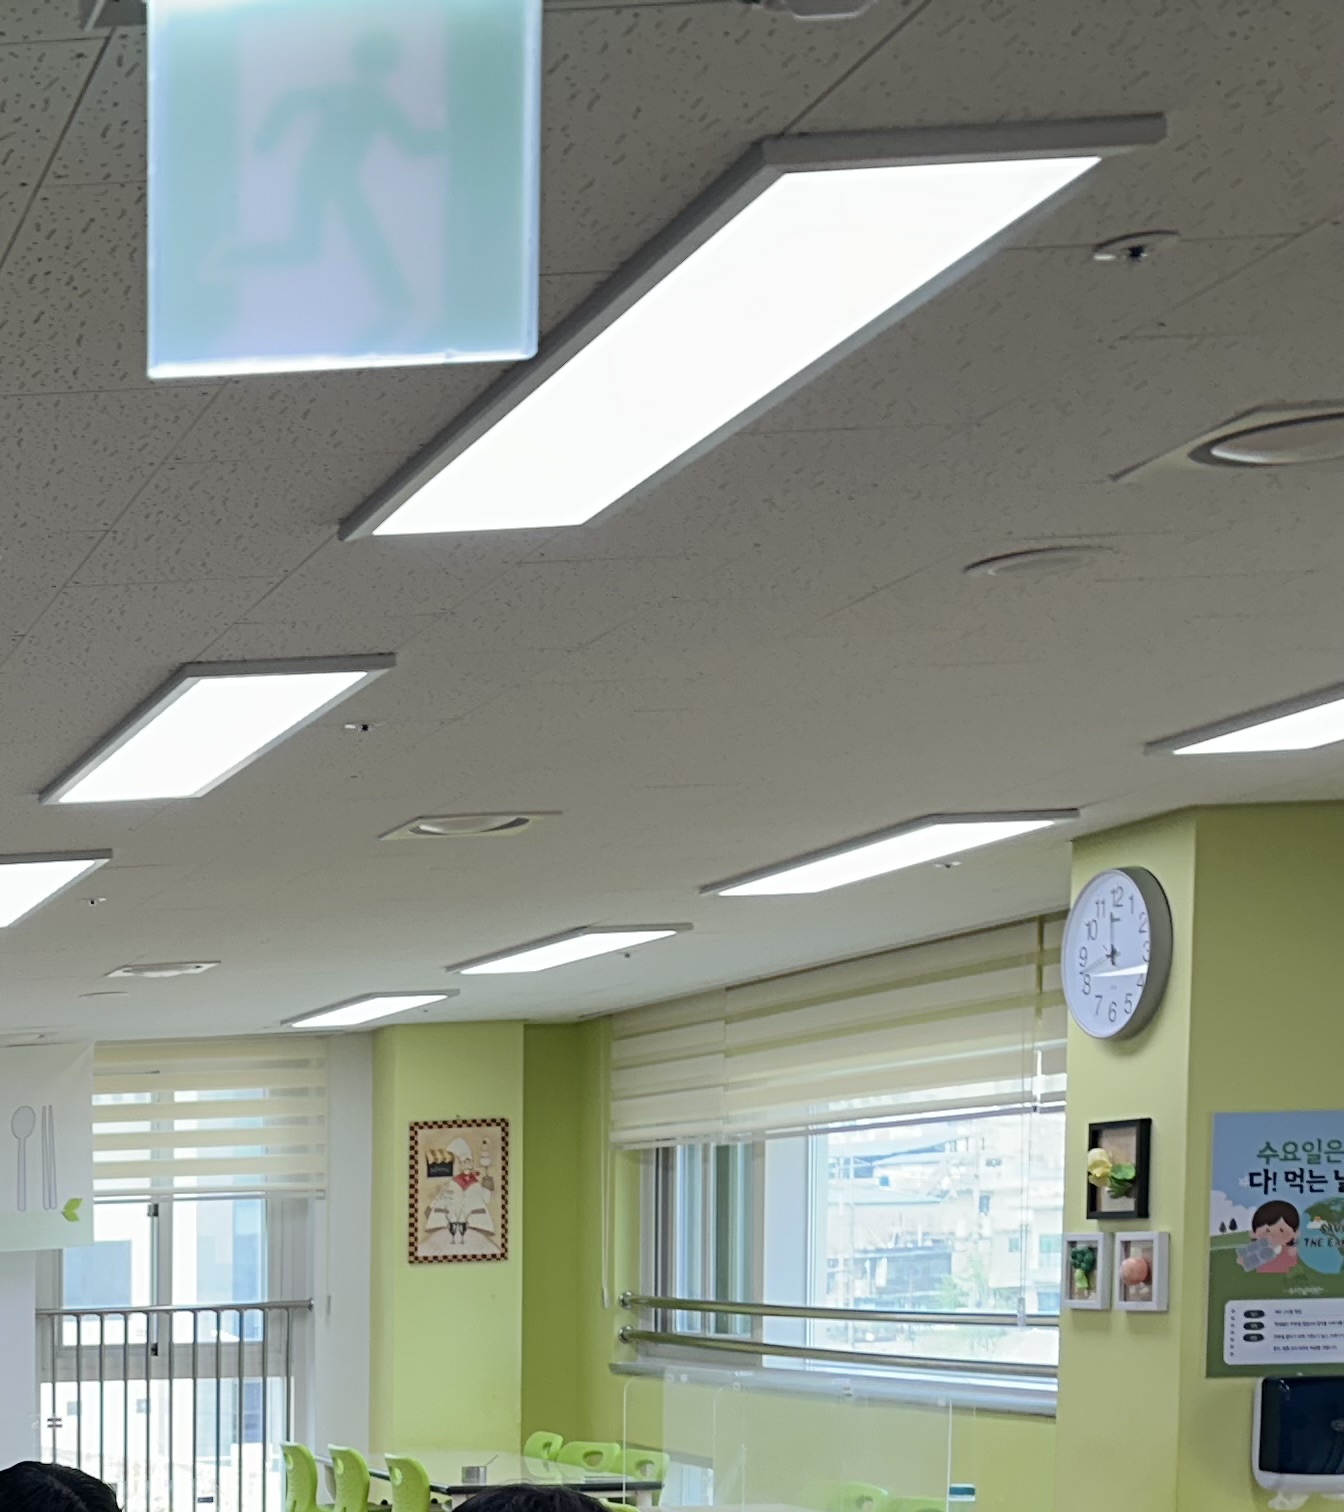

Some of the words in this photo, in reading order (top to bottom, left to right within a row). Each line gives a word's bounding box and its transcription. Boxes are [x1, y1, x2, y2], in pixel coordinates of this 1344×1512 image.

[1110, 886, 1124, 908] 12
[1129, 895, 1135, 915] 1
[1095, 898, 1106, 919] 11
[1085, 919, 1098, 941] 10
[1138, 912, 1148, 934] 2
[1079, 946, 1089, 968] 9
[1142, 941, 1150, 963] 3
[1081, 973, 1092, 996] 8
[1094, 994, 1103, 1017] 7
[1108, 1001, 1117, 1023] 6
[1123, 993, 1133, 1014] 5
[1256, 1138, 1344, 1165] 수요일은
[1248, 1167, 1278, 1195] 다!
[1284, 1167, 1328, 1194] 먹는
